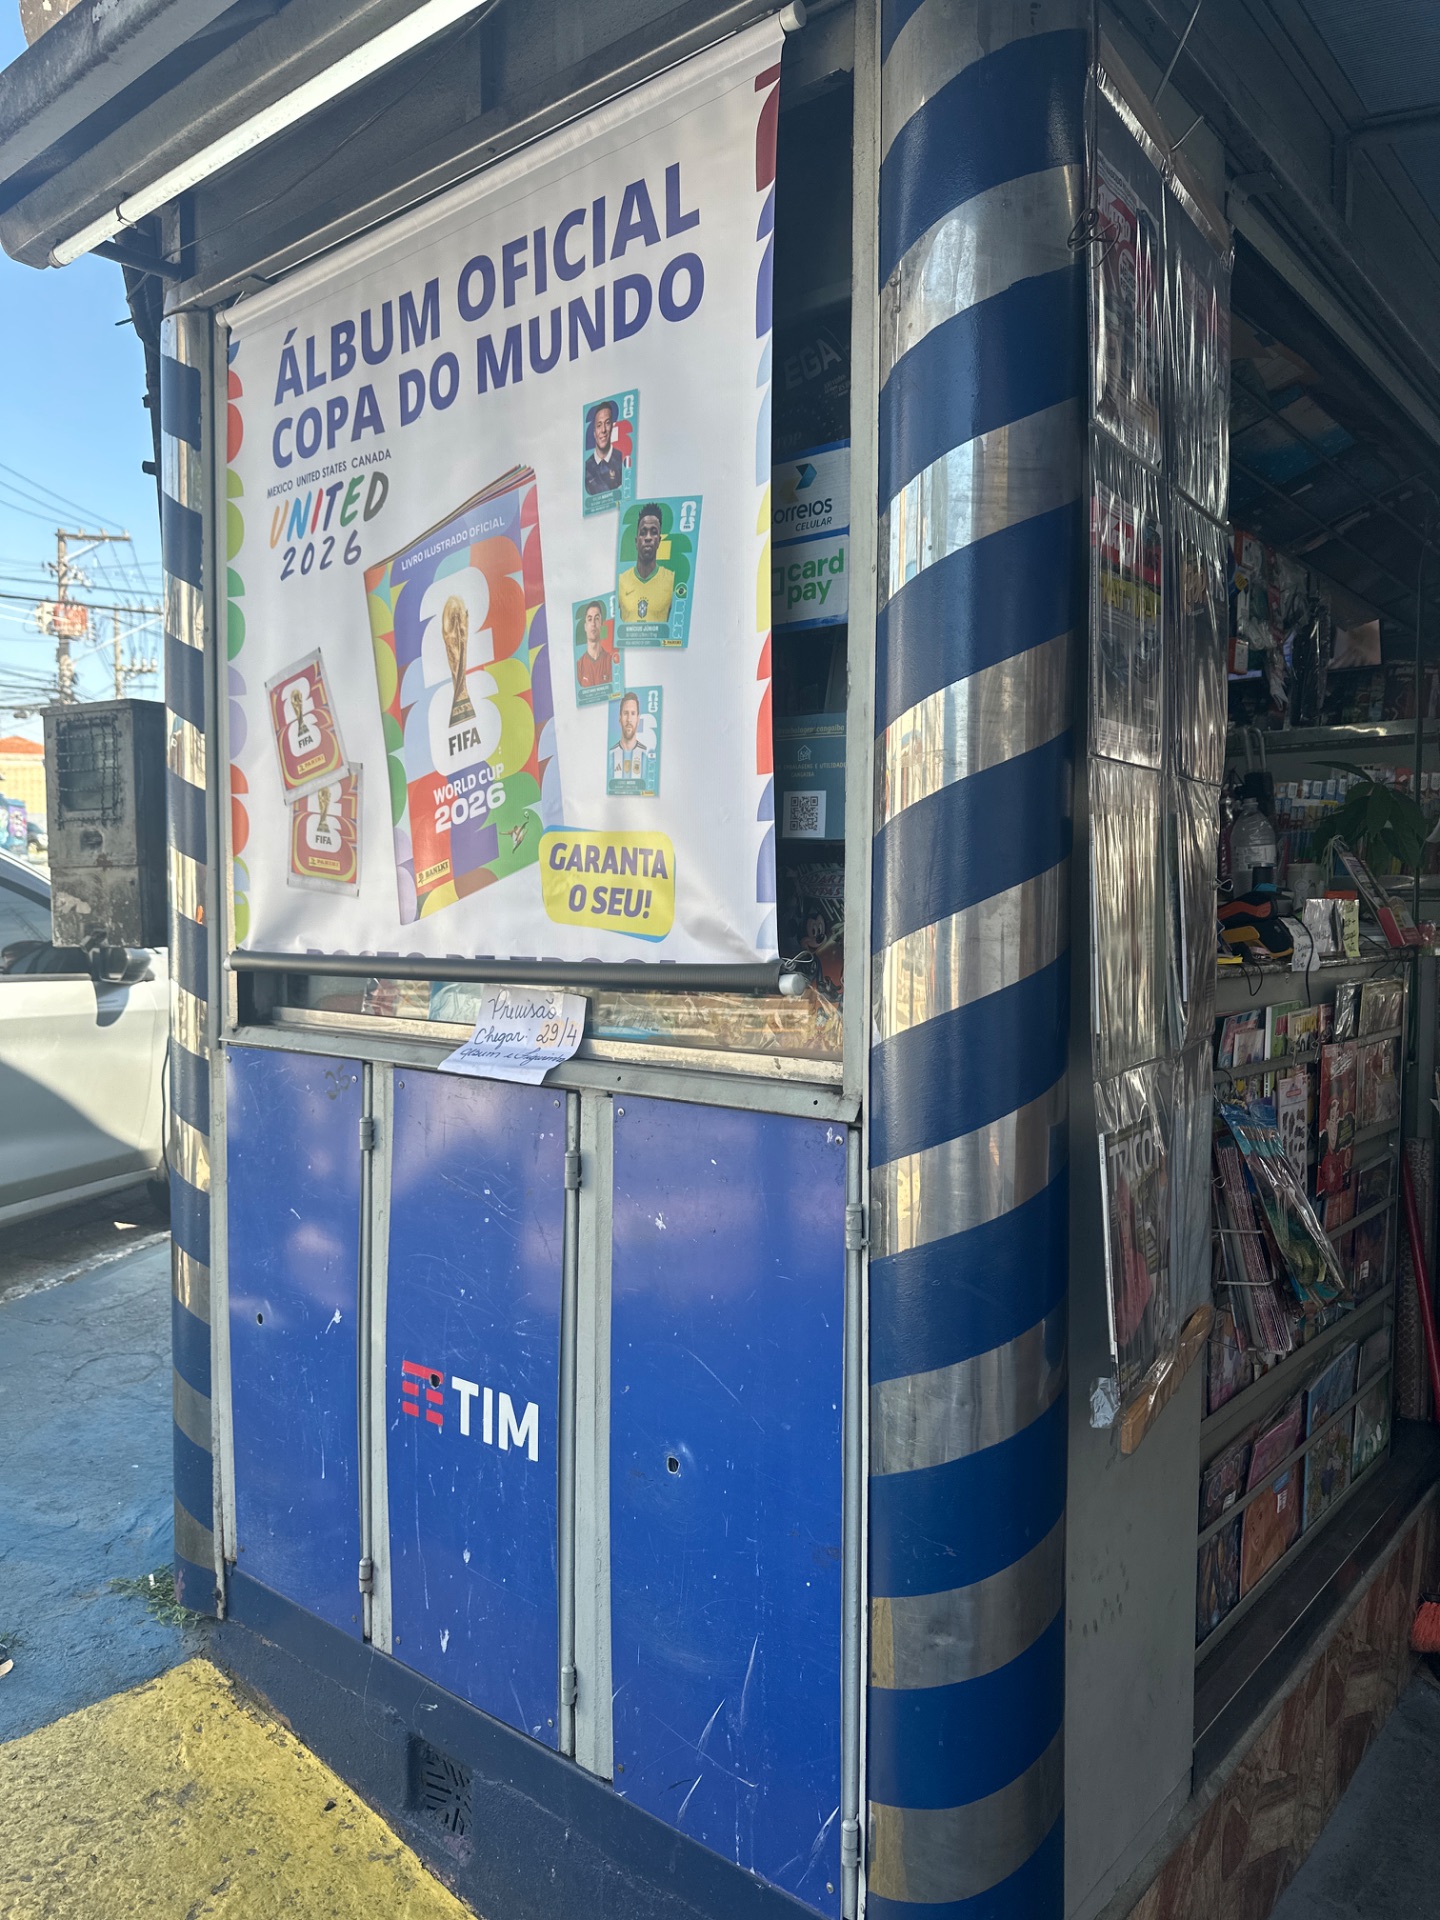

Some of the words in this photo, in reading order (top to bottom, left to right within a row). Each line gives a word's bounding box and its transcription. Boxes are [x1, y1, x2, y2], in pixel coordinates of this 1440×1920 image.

[273, 277, 441, 406] ÁLBUM
[457, 161, 701, 322] OFICIAL
[272, 384, 386, 468] COPA
[398, 351, 461, 428] DO
[477, 252, 705, 395] MUNDO
[267, 480, 293, 499] MEXICO
[296, 470, 320, 487] UNITED
[322, 461, 347, 478] STATES
[351, 448, 391, 468] CANADA
[270, 471, 389, 549] UNITED
[774, 498, 832, 524] orreios
[795, 516, 832, 532] CELULAR
[280, 529, 362, 581] 2026
[401, 551, 424, 571] LIVRO
[424, 529, 468, 560] ILUSTRADO
[469, 516, 505, 538] OFICIAL
[787, 548, 844, 582] card
[787, 578, 832, 610] pay
[298, 735, 314, 748] FIFA
[449, 727, 481, 756] FIFA
[433, 774, 476, 805] WORLD
[478, 763, 505, 784] CUP
[434, 782, 506, 834] 2026
[315, 834, 332, 846] FIFA
[549, 842, 669, 880] GARANTA
[568, 884, 587, 912] O
[590, 886, 653, 919] SEU!
[536, 1017, 578, 1048] 29/4
[451, 1375, 539, 1462] TIM
